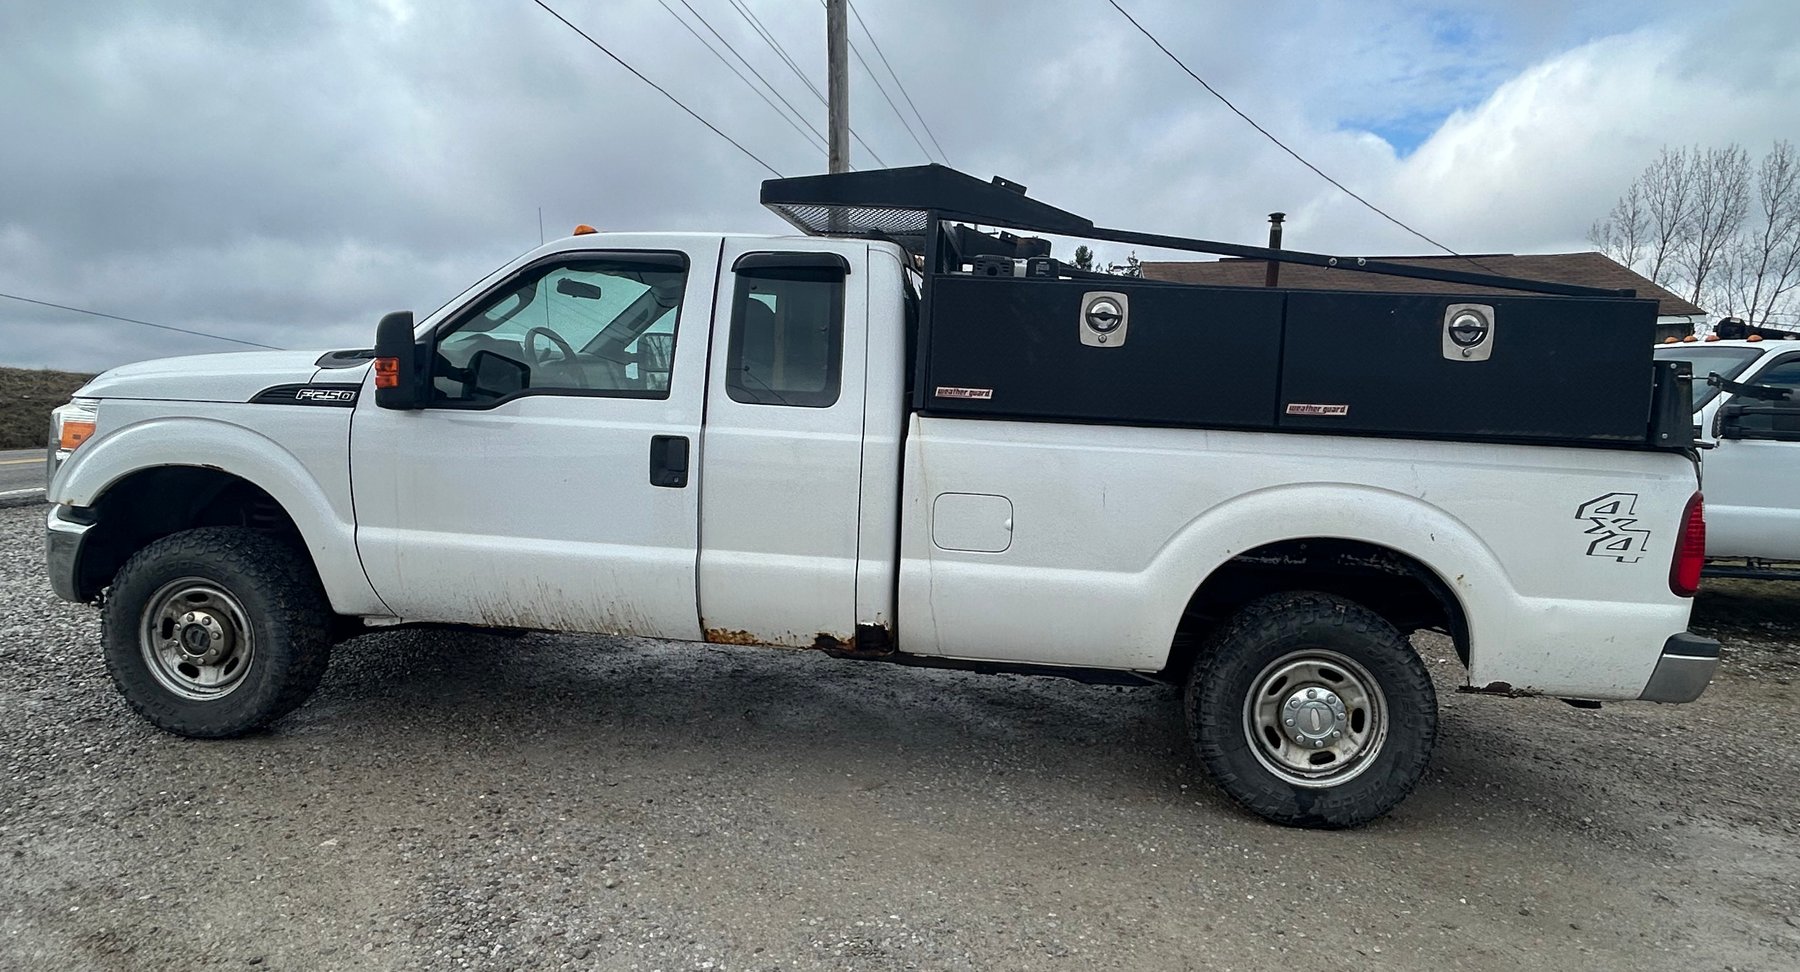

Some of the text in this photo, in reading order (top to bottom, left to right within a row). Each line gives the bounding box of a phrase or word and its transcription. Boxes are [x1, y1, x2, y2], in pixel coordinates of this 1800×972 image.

[296, 389, 356, 402] F250
[938, 388, 990, 398] weather guard
[1323, 405, 1345, 414] guard
